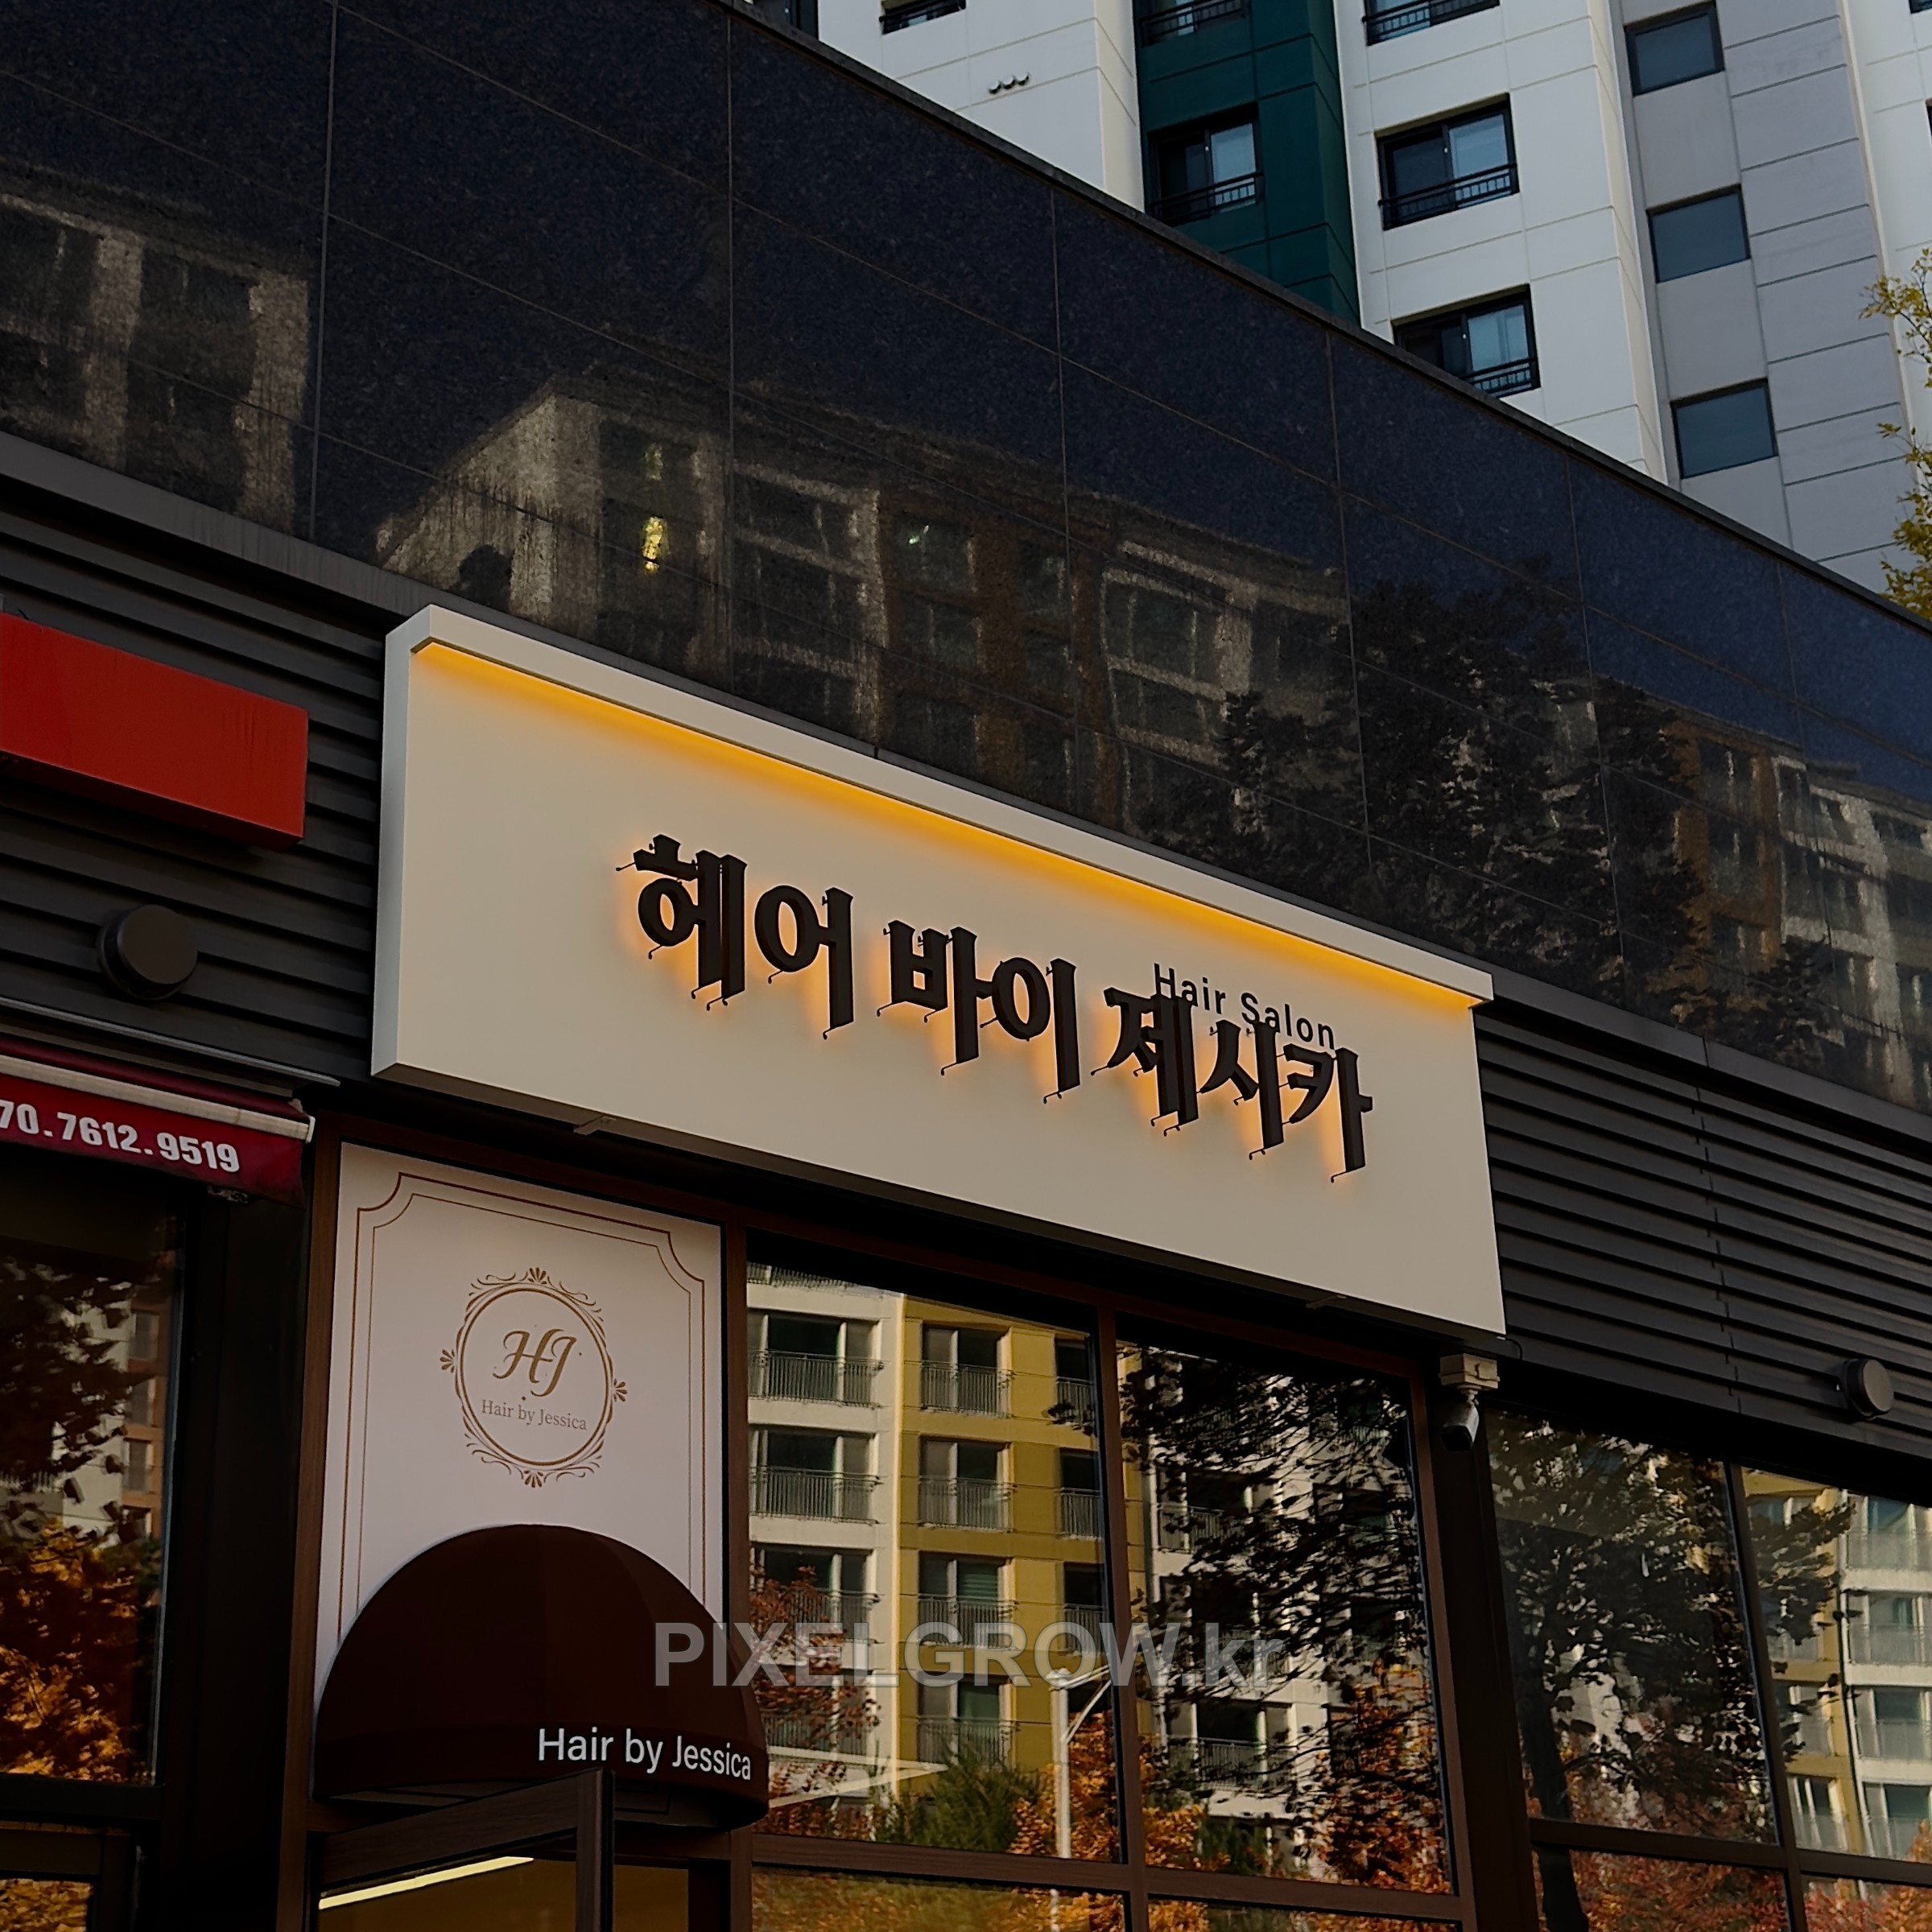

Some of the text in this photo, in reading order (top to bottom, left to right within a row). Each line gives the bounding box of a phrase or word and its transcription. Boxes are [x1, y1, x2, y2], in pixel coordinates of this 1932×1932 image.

[634, 835, 1373, 1173] 헤어 바이 제시카
[1154, 963, 1335, 1050] Hair Salon
[493, 1328, 577, 1397] HJ
[481, 1399, 587, 1430] Hair by Jessica
[539, 1726, 751, 1781] Hair by Jessica
